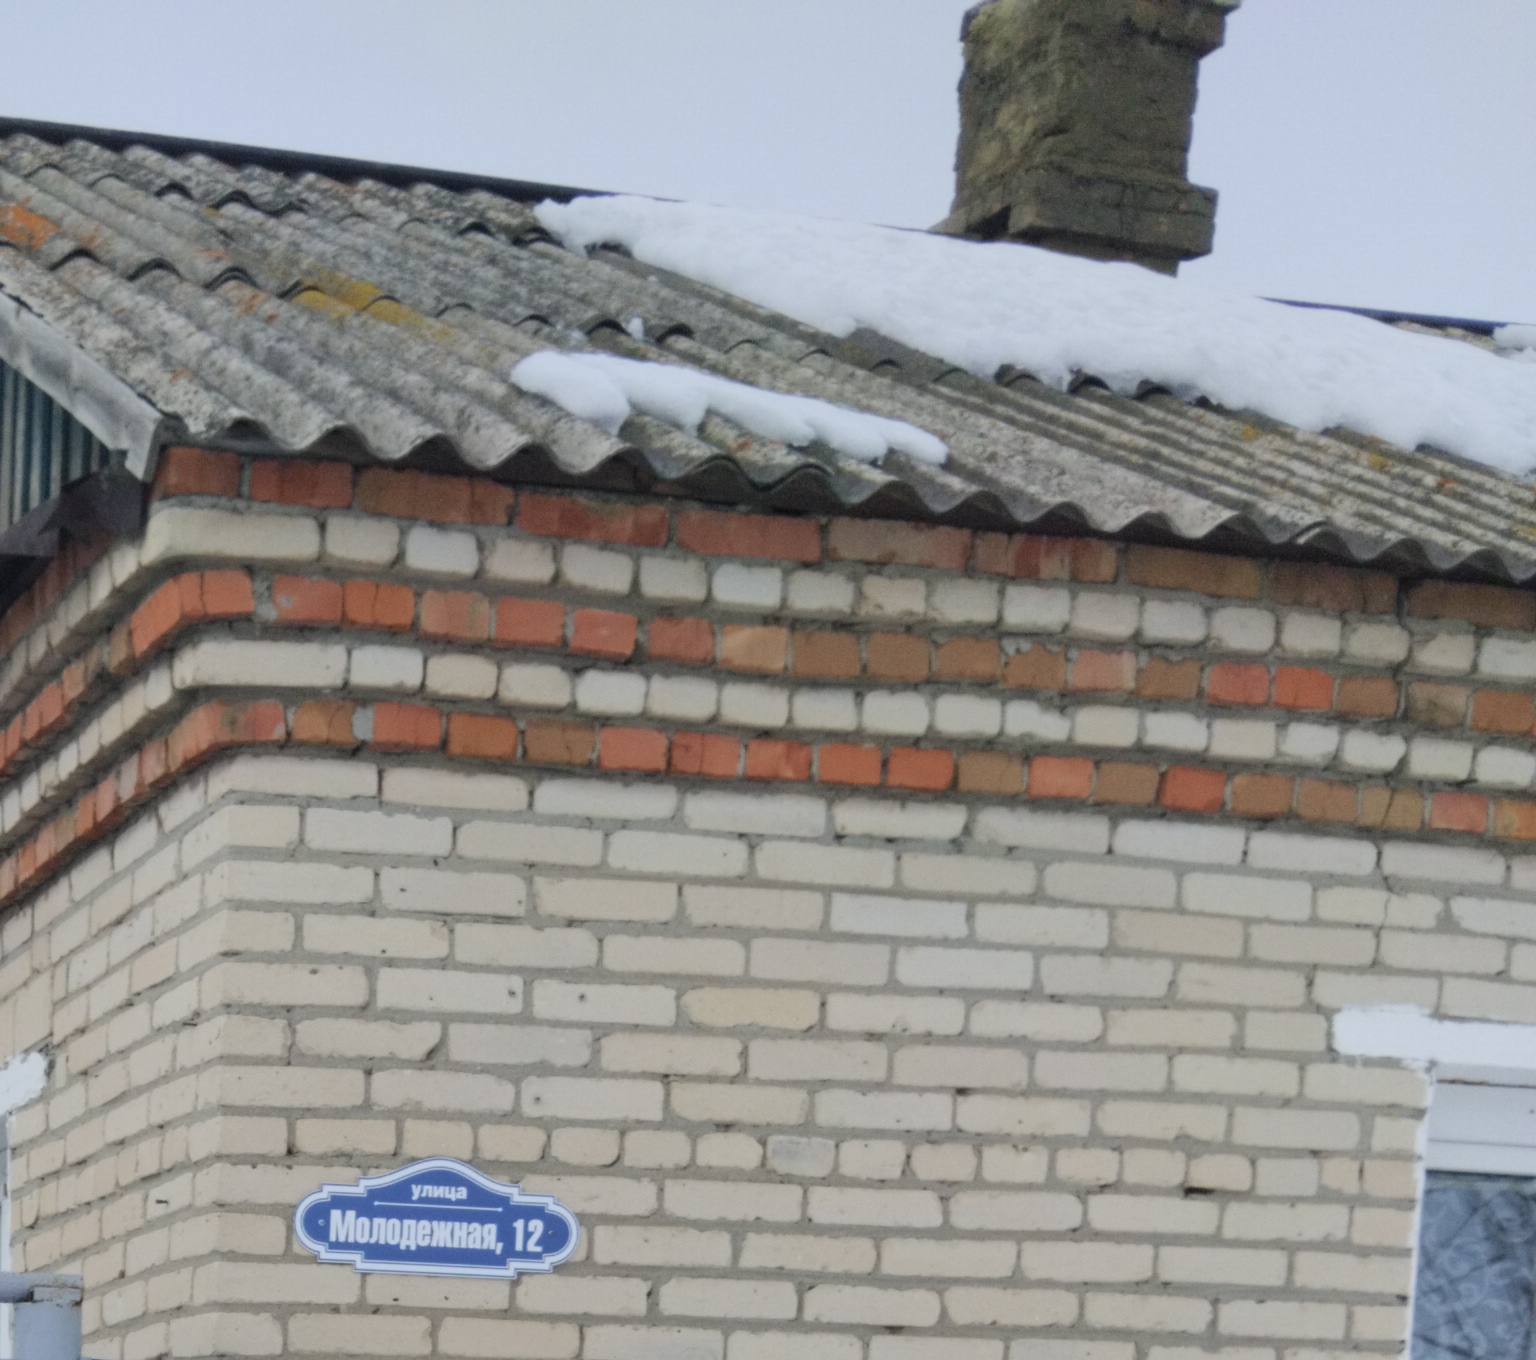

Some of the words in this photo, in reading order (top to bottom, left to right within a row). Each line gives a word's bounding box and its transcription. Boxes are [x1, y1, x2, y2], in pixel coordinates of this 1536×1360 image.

[410, 1184, 467, 1200] улица
[329, 1208, 504, 1255] Молодежная,
[513, 1218, 544, 1252] 12
